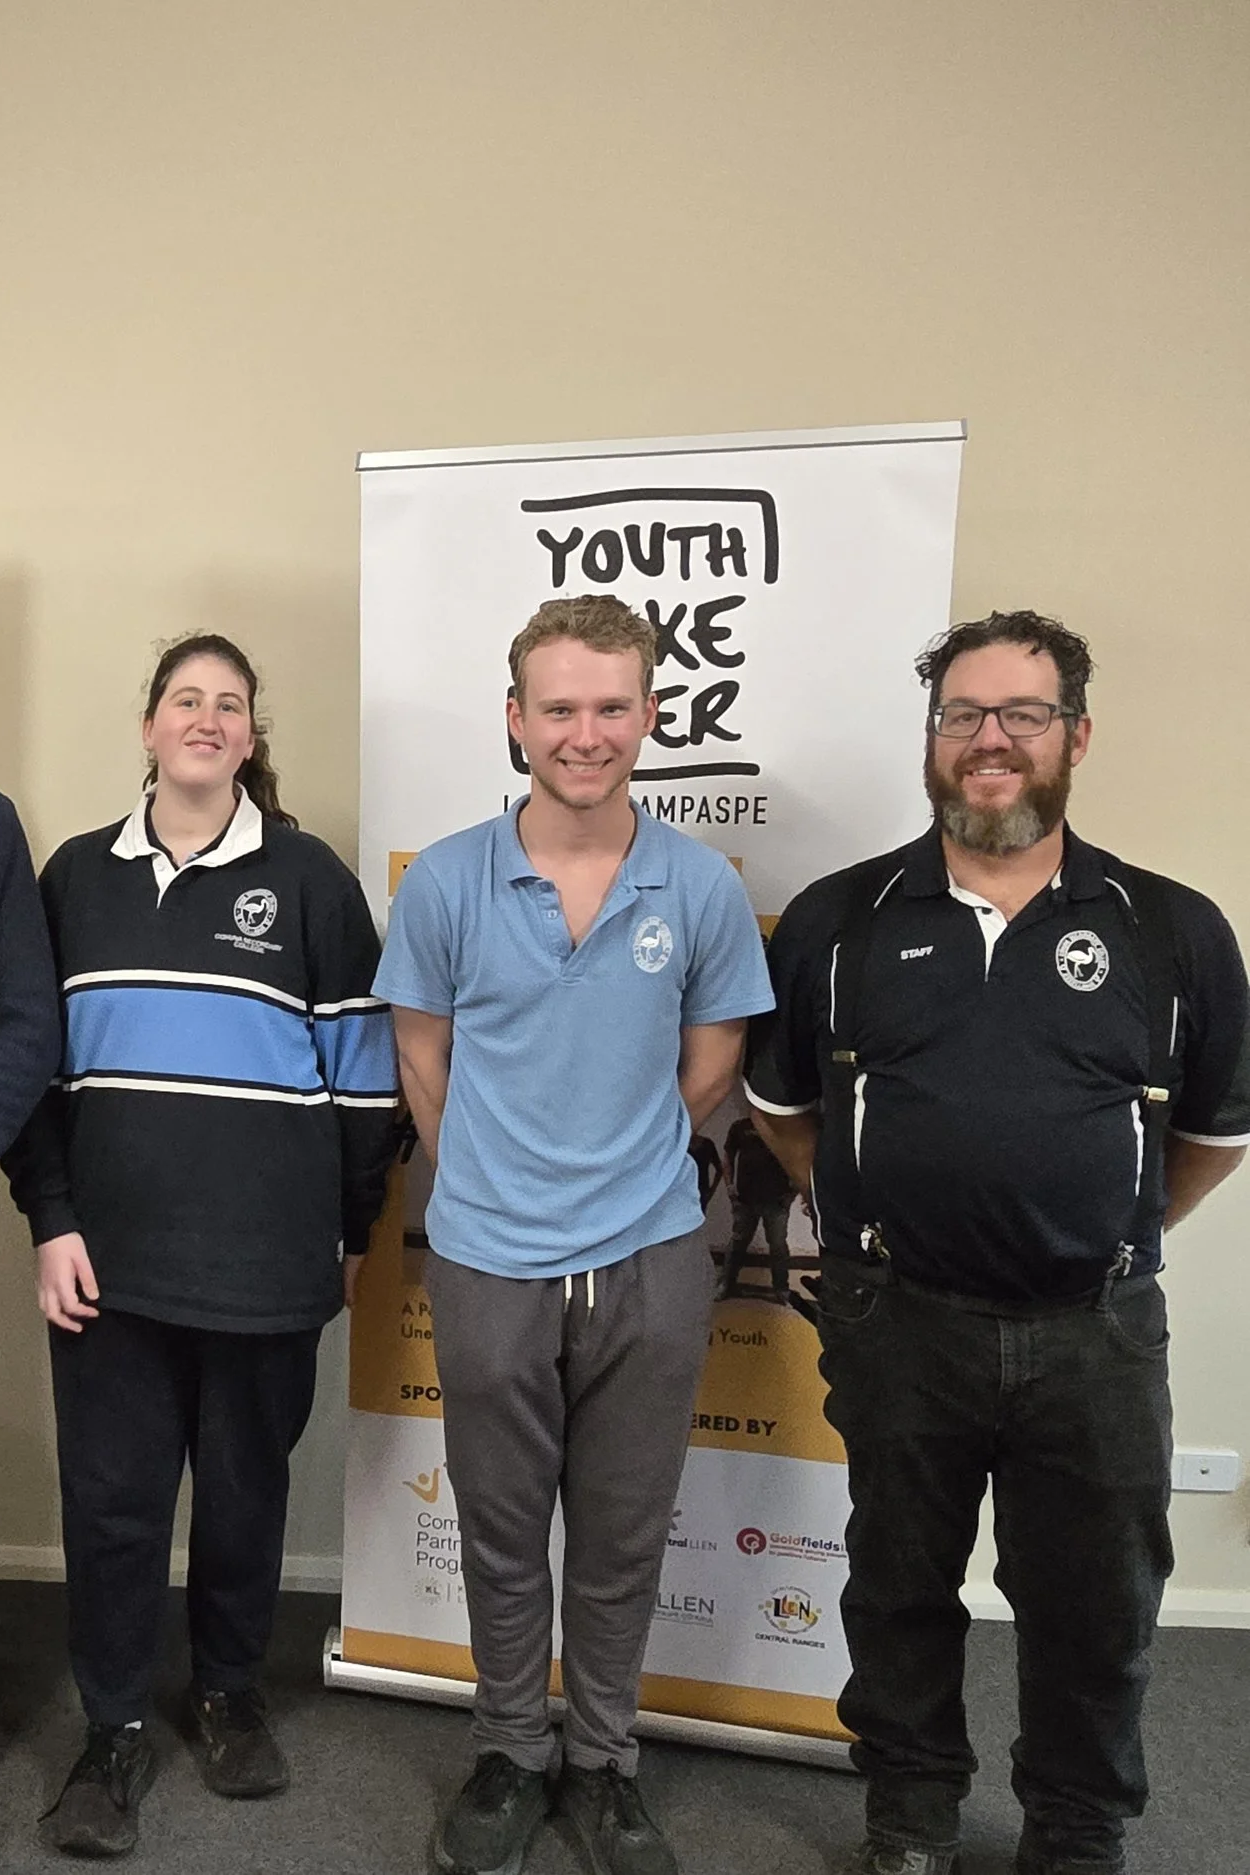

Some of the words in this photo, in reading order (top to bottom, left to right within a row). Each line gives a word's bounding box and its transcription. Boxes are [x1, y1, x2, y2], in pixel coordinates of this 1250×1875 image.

[537, 522, 747, 588] YOUTH
[641, 795, 768, 825] AMPASPE
[901, 946, 934, 960] STAFF
[402, 1302, 414, 1316] A
[718, 1328, 768, 1346] Youth
[400, 1384, 441, 1401] SPO
[746, 1418, 777, 1436] BY
[770, 1532, 840, 1552] Goldfields
[755, 1632, 790, 1645] CENTRAL
[792, 1638, 825, 1649] RANGES
